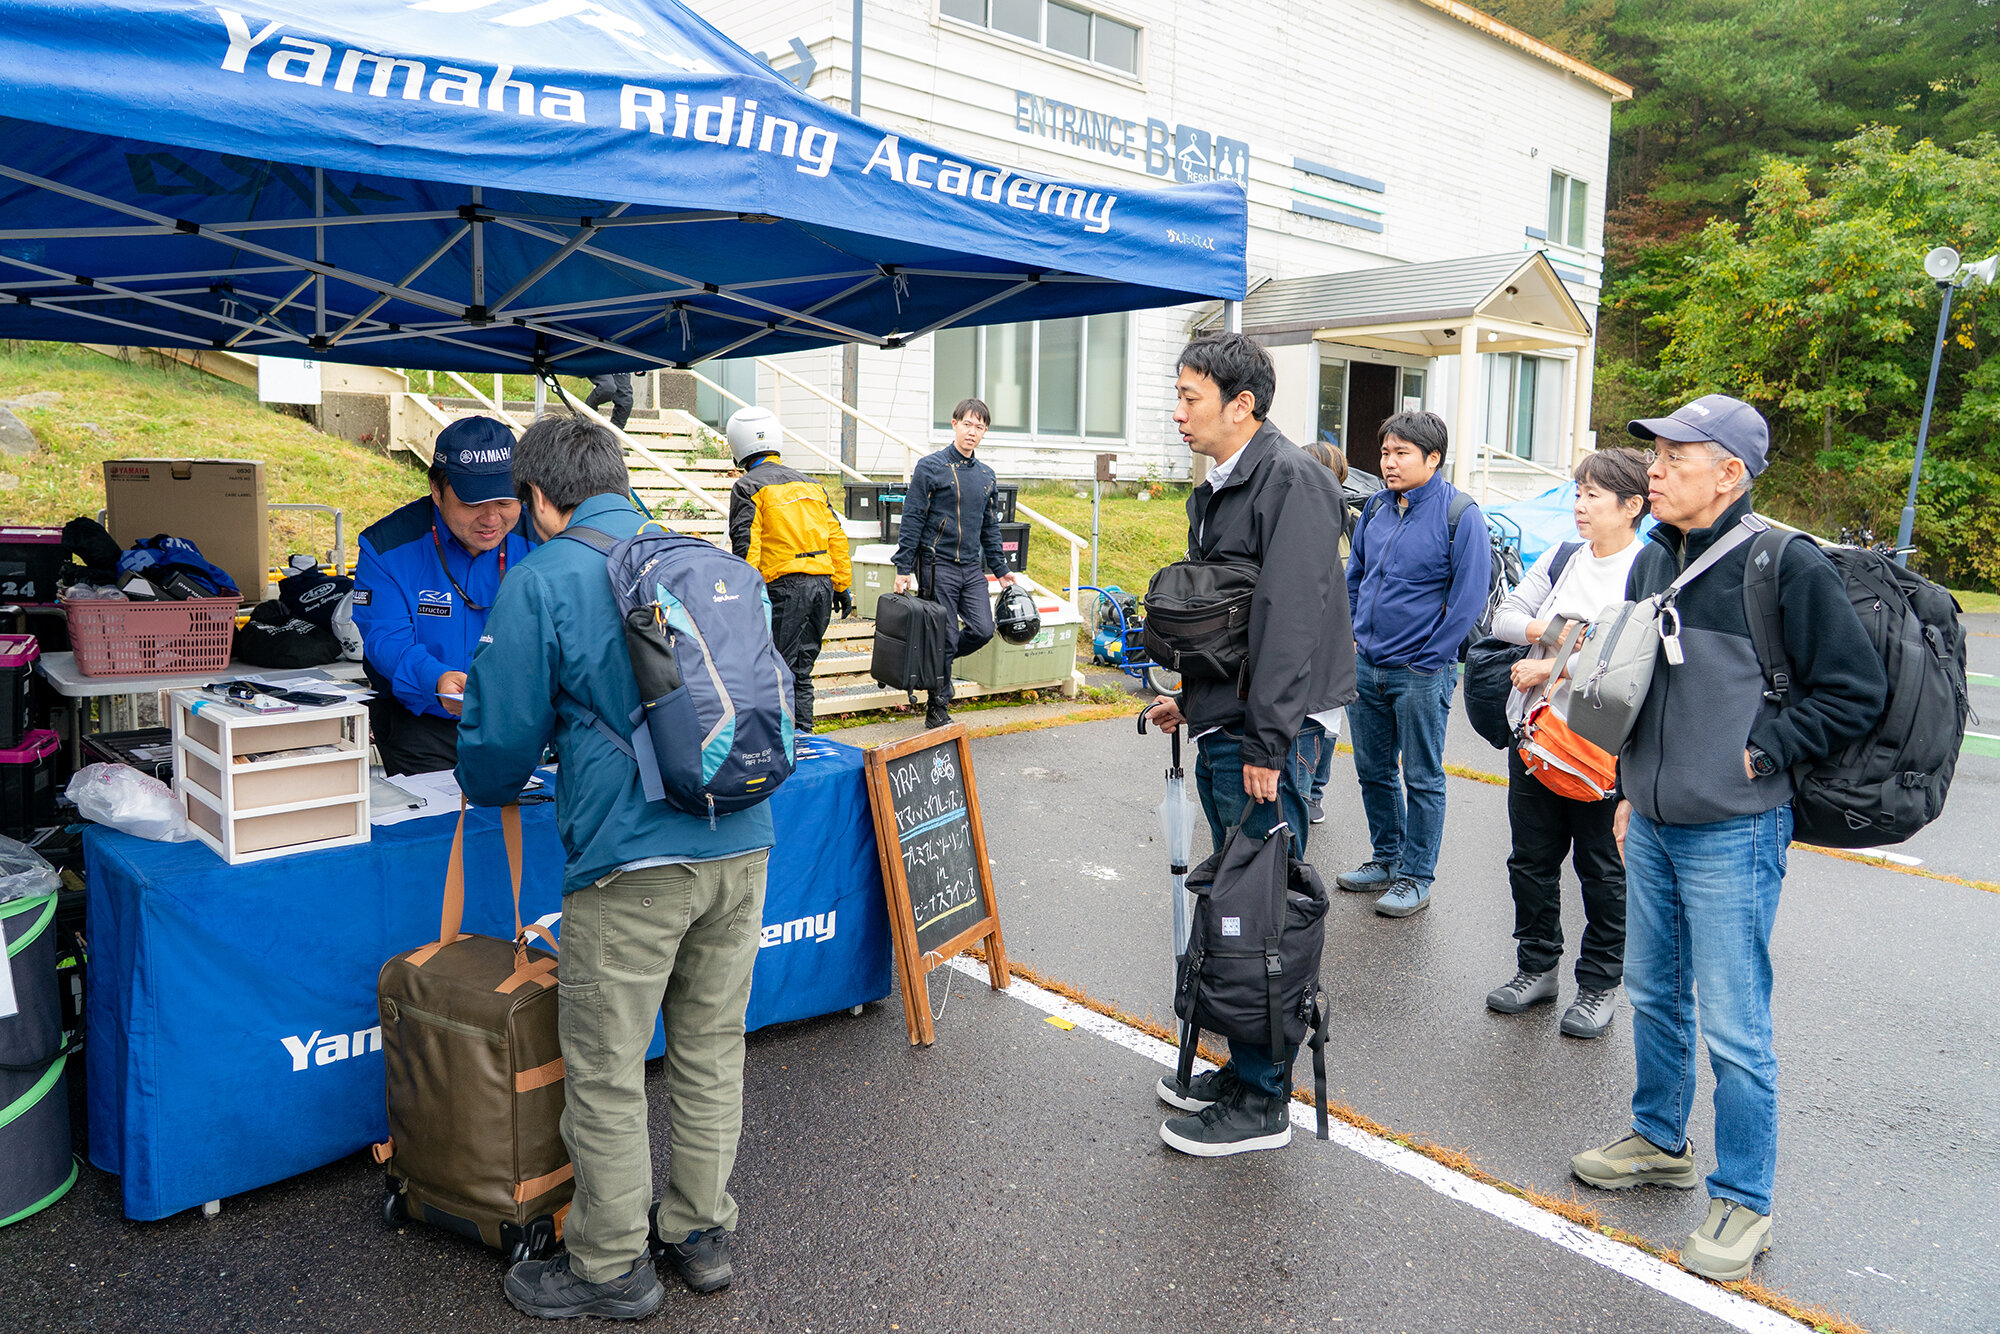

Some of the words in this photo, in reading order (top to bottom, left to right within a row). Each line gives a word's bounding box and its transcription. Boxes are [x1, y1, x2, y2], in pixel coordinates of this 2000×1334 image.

[215, 7, 587, 124] Yamaha
[619, 84, 839, 178] Riding
[861, 133, 1119, 234] Academy
[1016, 90, 1136, 160] ENTRANCE
[1146, 117, 1170, 177] B
[1166, 229, 1215, 251] かんたんてんと
[119, 467, 150, 475] YAMAHA
[1, 580, 36, 598] 24
[890, 763, 921, 798] YRA
[936, 865, 949, 885] in
